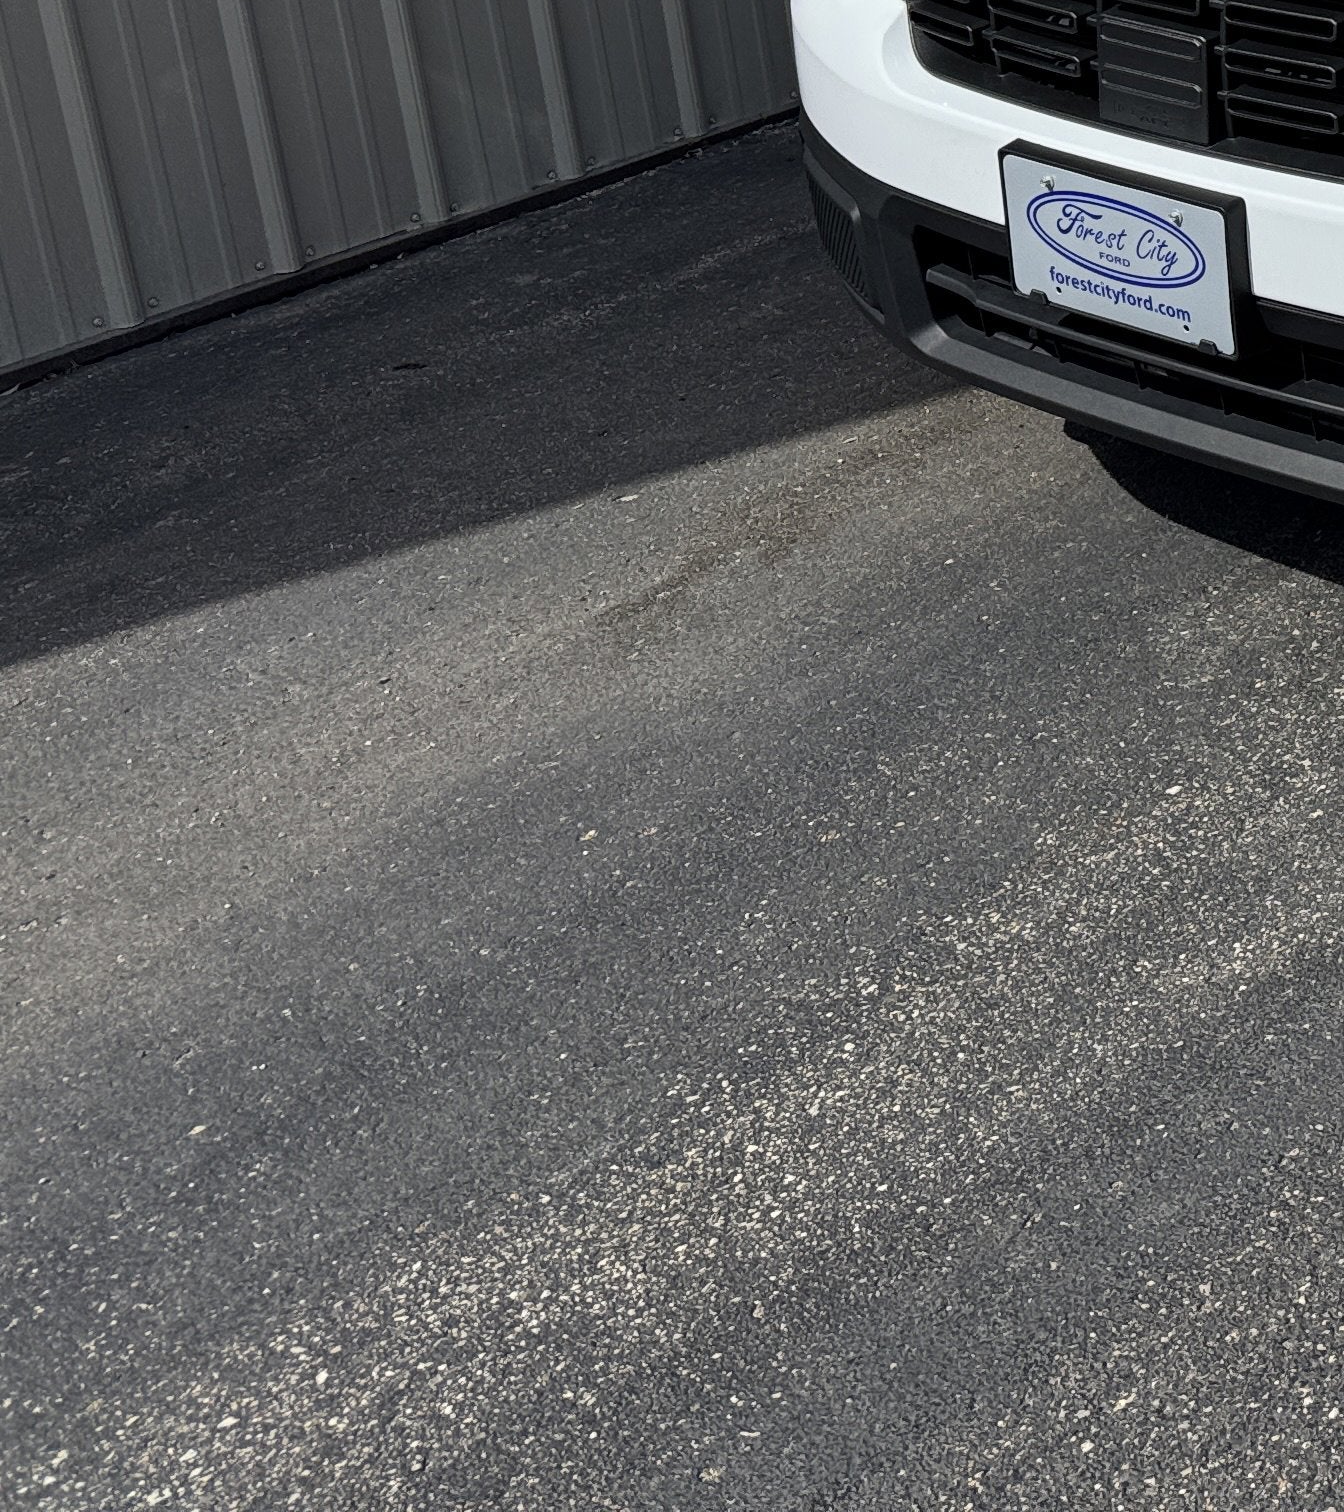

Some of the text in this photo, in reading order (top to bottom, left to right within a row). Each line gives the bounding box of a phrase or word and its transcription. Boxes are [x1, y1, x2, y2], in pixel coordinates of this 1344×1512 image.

[1056, 203, 1179, 276] Forest City
[1098, 251, 1131, 268] FORD
[1049, 265, 1192, 323] forestcityford.com
